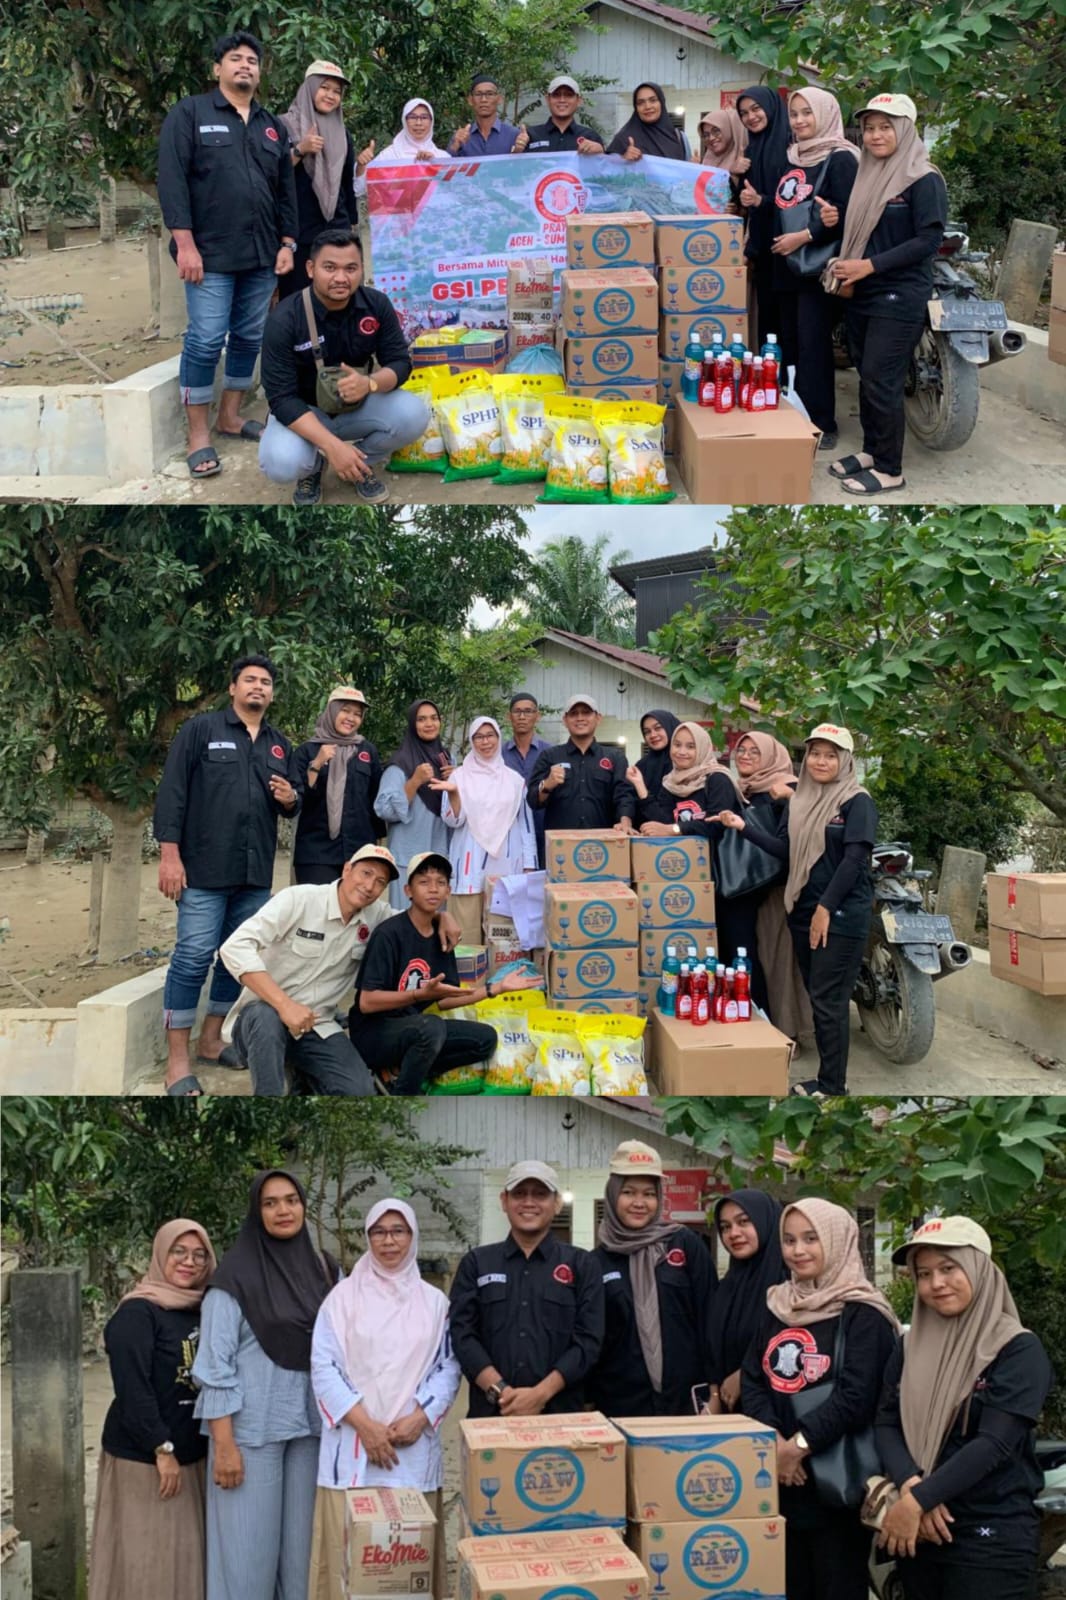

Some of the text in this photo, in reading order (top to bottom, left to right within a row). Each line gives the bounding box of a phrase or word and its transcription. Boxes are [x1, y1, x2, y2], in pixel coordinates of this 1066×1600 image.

[509, 235, 534, 248] ACEH
[438, 260, 484, 272] Bersama
[432, 280, 474, 301] GSI
[514, 281, 551, 295] EkoMie
[691, 281, 720, 291] RAW
[462, 407, 499, 426] SPHP
[664, 896, 690, 906] RAW
[583, 914, 612, 926] RAW
[581, 965, 611, 976] RAW
[523, 1470, 576, 1490] RAW
[361, 1543, 430, 1567] EkoMie
[691, 1548, 741, 1567] RAW
